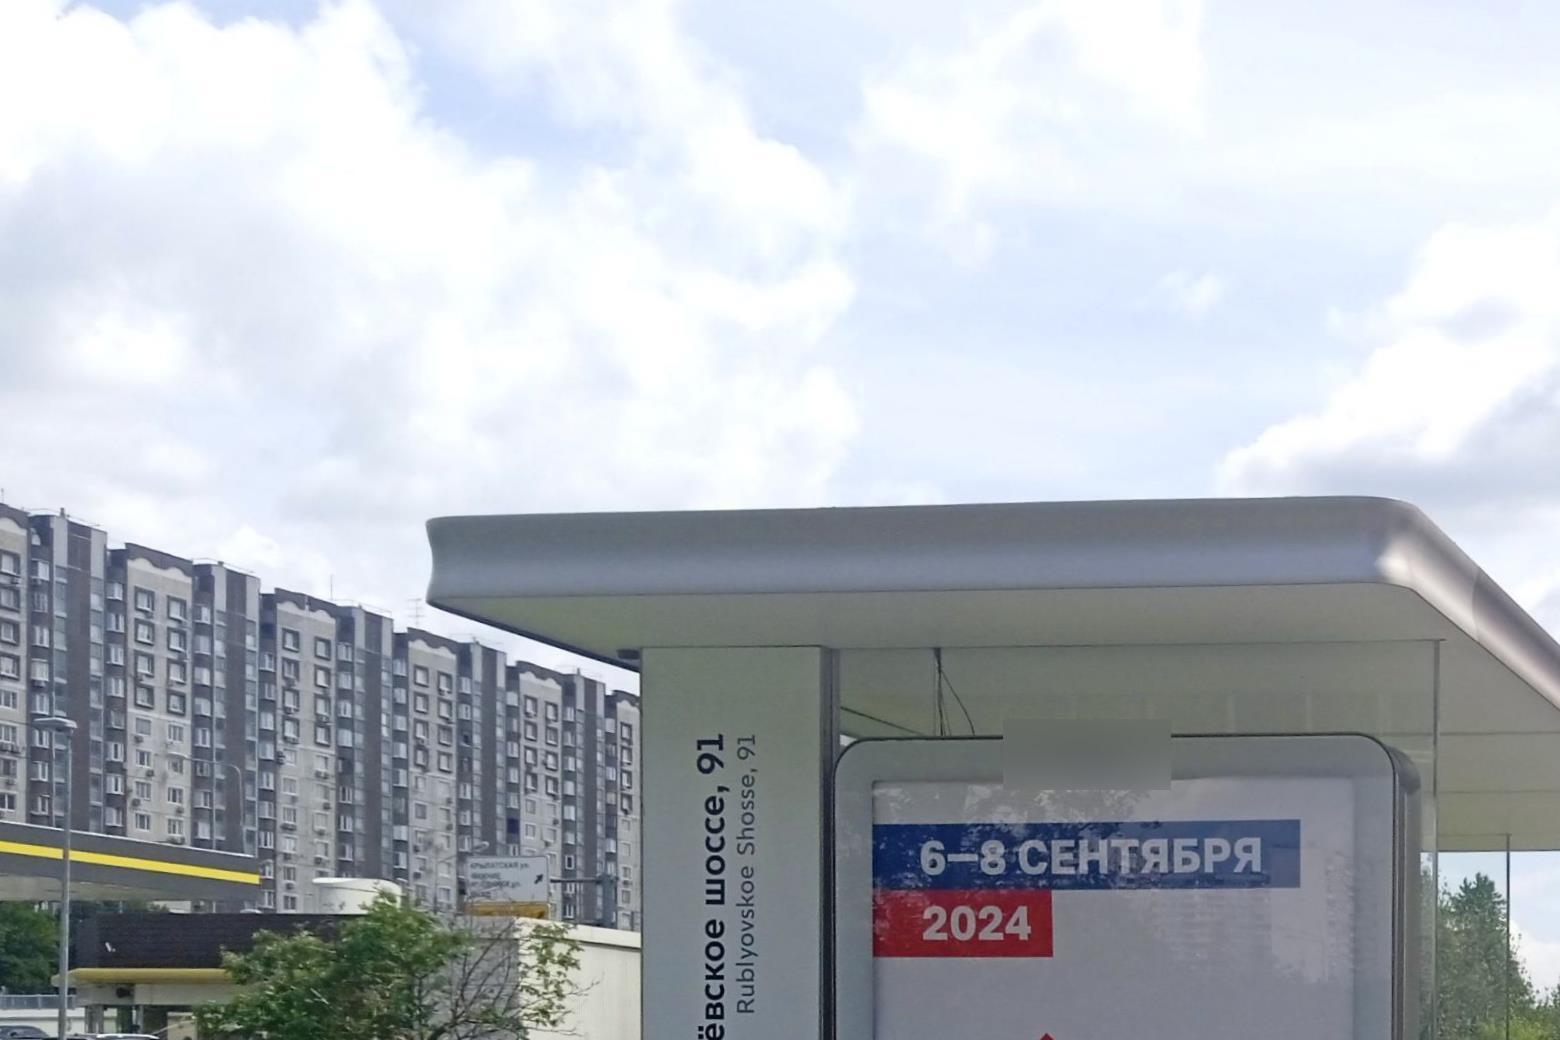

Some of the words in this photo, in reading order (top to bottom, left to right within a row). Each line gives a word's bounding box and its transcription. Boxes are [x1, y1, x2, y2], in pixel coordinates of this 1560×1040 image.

[697, 733, 725, 774] 91
[736, 734, 756, 761] 91
[736, 769, 758, 856] Shosse,
[704, 782, 730, 905] шоссе,
[1018, 835, 1264, 876] СЕНТЯБРЯ
[736, 865, 759, 1014] Rublyovskoe
[923, 906, 1032, 941] 2024
